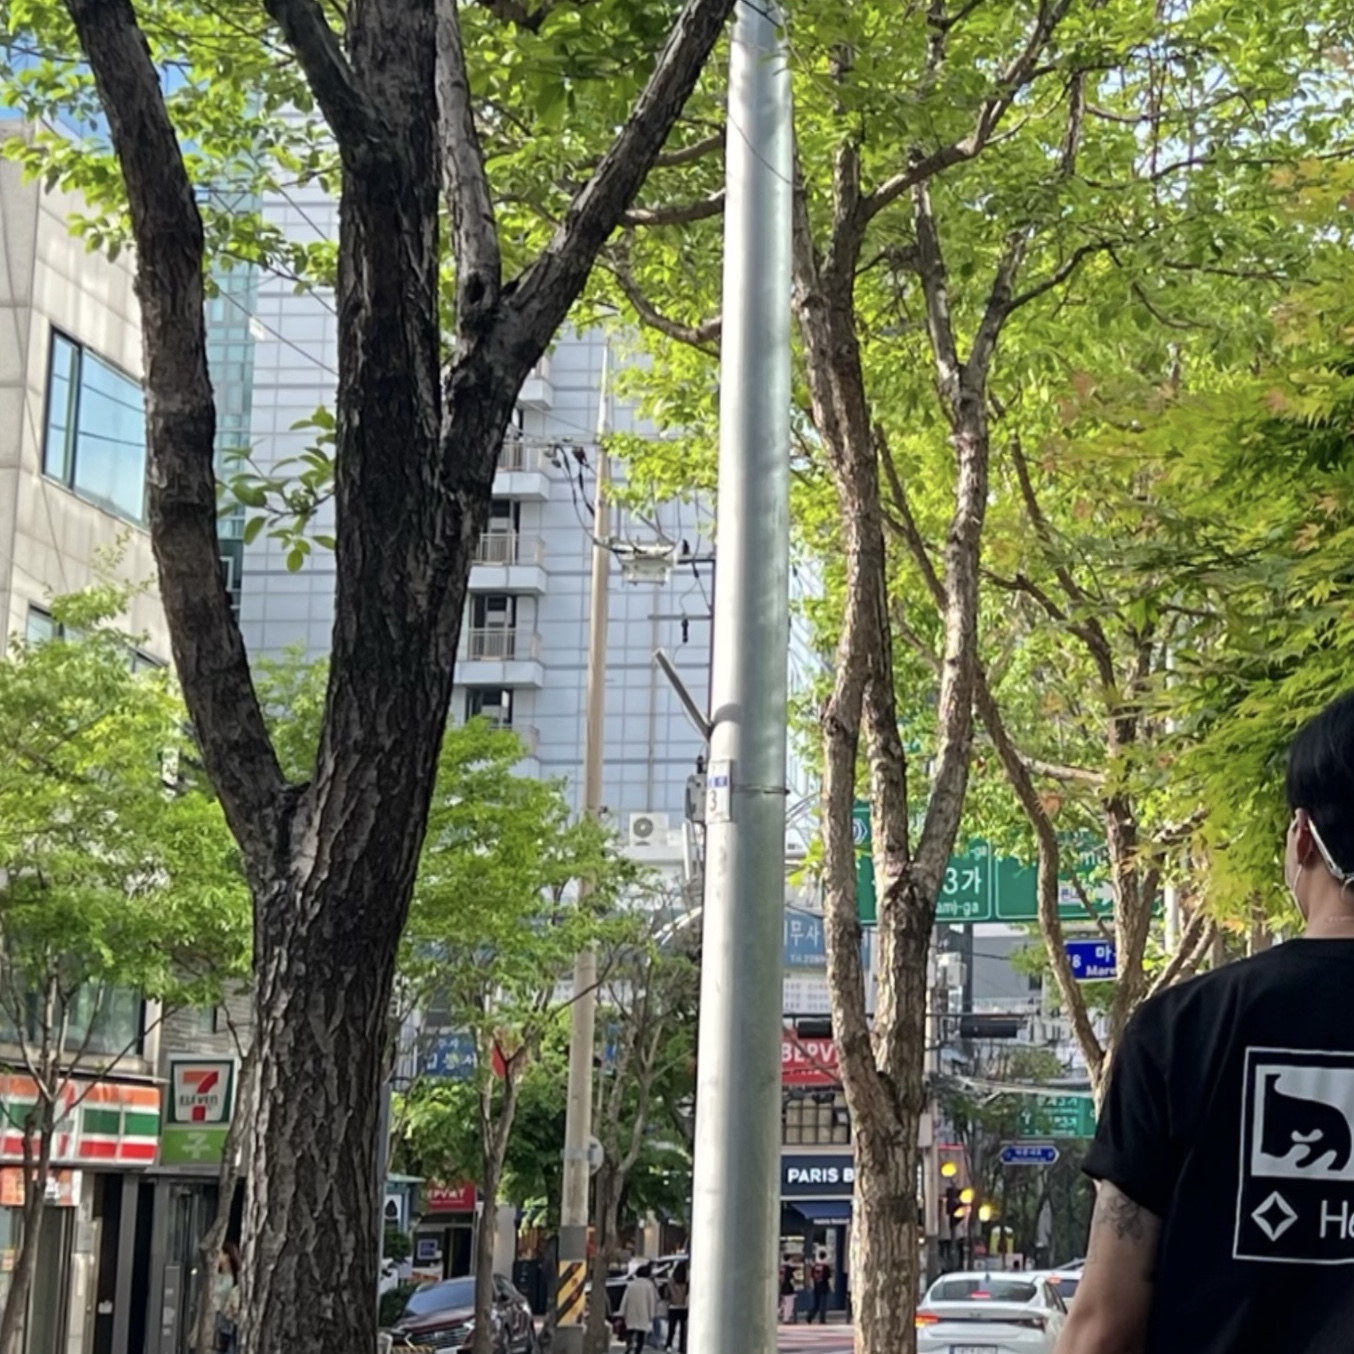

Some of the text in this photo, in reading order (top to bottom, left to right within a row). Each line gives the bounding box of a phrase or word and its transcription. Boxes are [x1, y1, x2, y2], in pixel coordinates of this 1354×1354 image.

[783, 919, 821, 949] 무사
[1095, 944, 1117, 963] 마
[787, 1167, 839, 1184] PARIS
